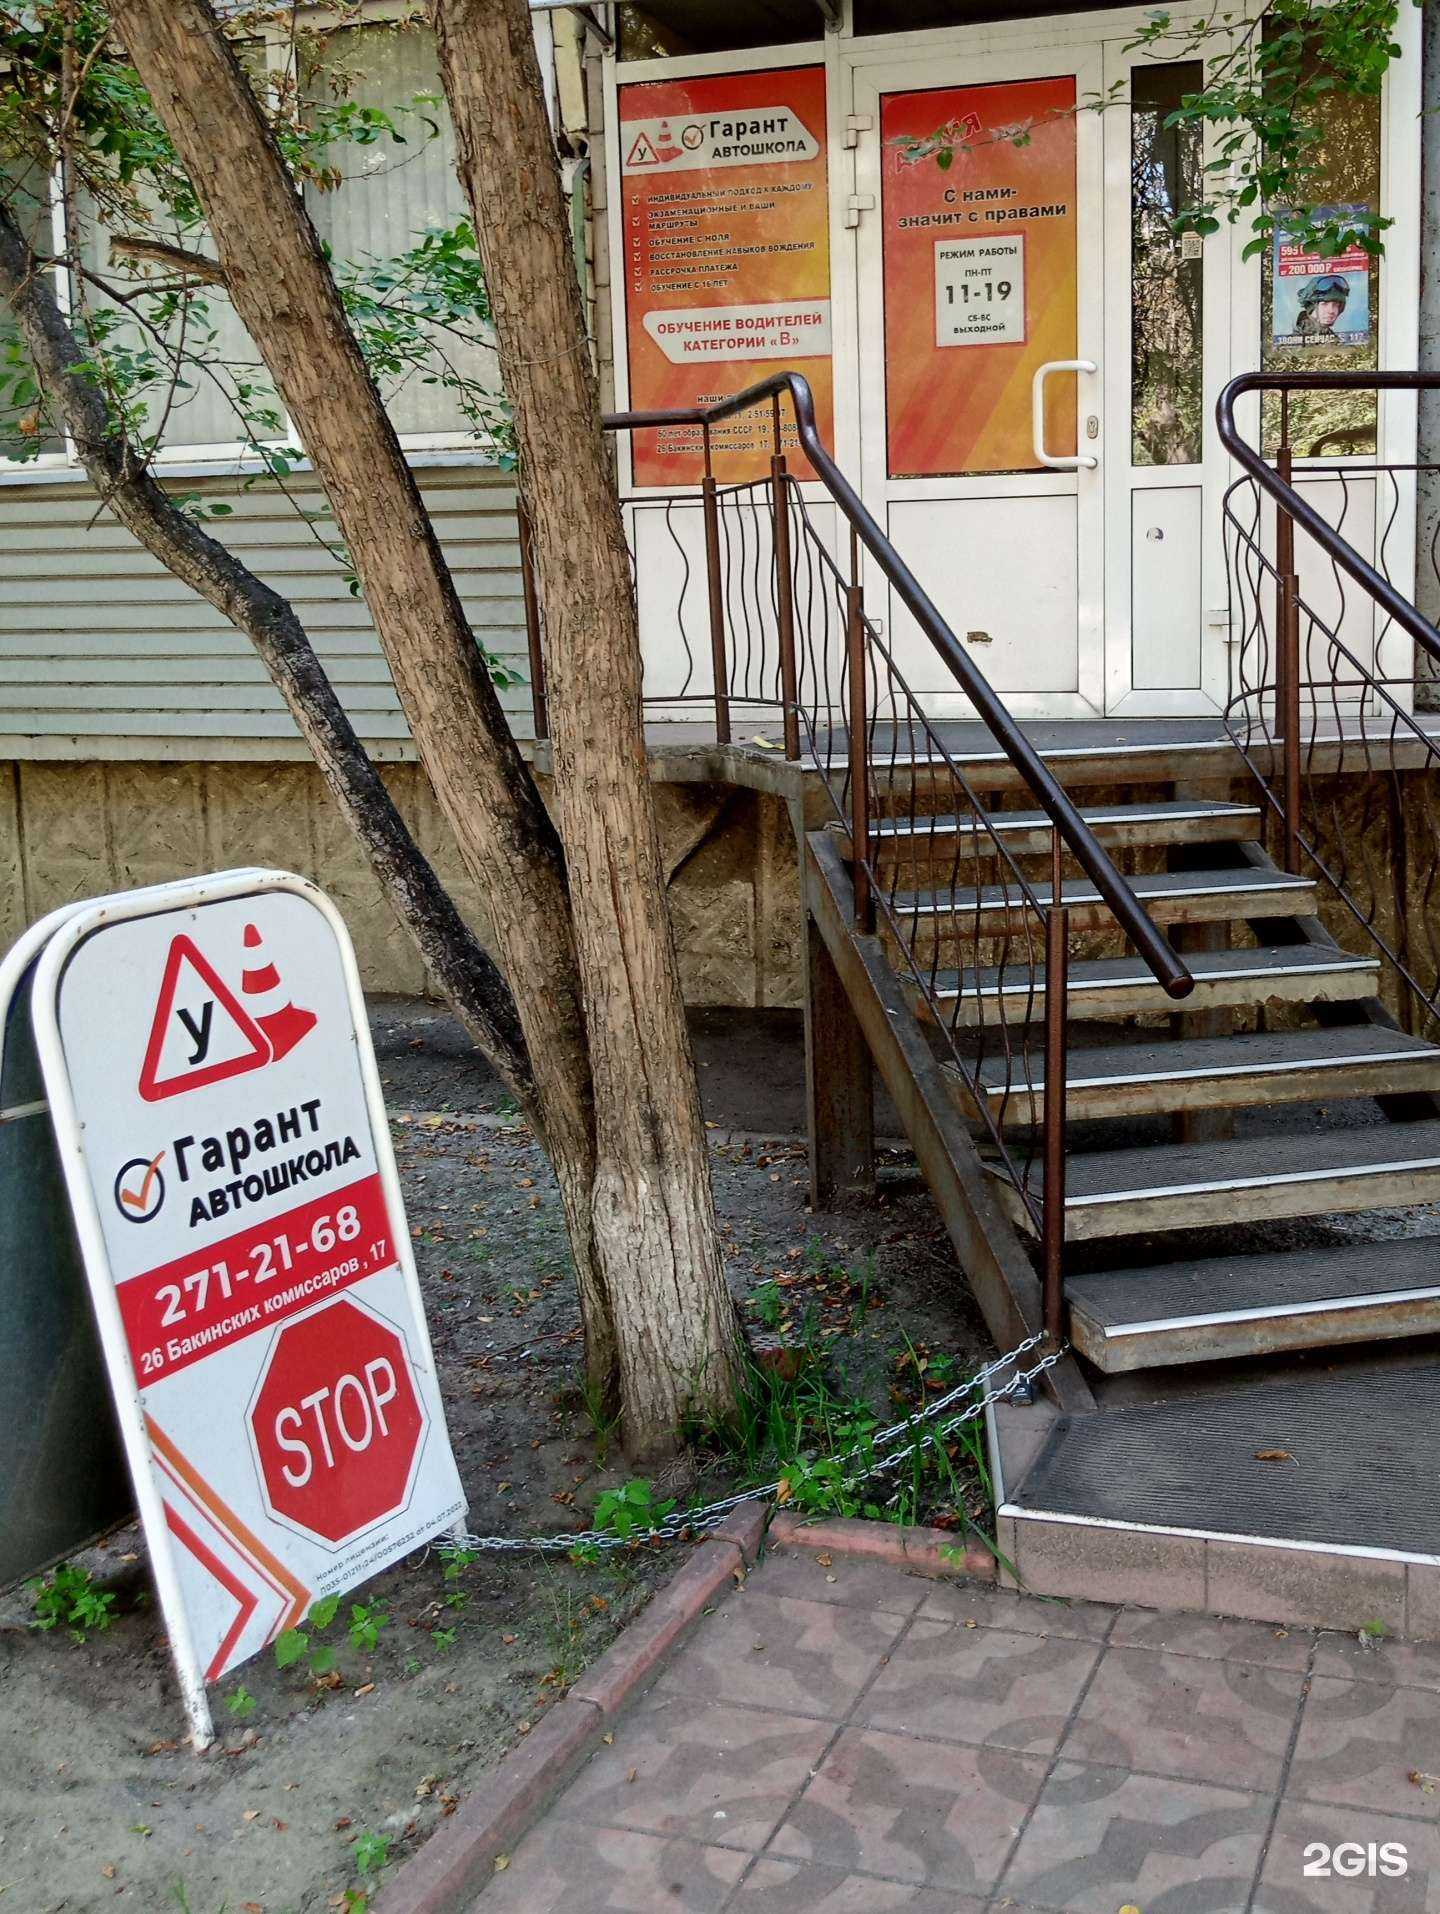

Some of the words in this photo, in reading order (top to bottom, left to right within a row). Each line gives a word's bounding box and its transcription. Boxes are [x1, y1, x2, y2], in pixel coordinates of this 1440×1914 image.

[710, 117, 788, 141] Гарант
[712, 140, 807, 159] АВТОШКОЛА
[963, 187, 1017, 202] нами-
[648, 220, 698, 230] МАРШРУТЫ
[898, 214, 962, 228] значит
[968, 213, 978, 222] с
[985, 204, 1067, 223] правами
[649, 236, 695, 247] ОБУЧЕНИЕ
[705, 233, 730, 242] НОЛЯ
[650, 248, 725, 260] ВОССТАНОВЛЕНИЕ
[727, 245, 766, 255] НАВЫКОВ
[768, 241, 815, 252] ВОЖДЕНИЯ
[940, 249, 975, 260] РЕЖИМ
[979, 246, 1018, 257] РАБОТЫ
[650, 266, 697, 276] РАССРОЧКА
[699, 263, 738, 273] ПЛАТЕЖА
[965, 268, 992, 278] ПН-ПТ
[1288, 265, 1305, 275] 200
[651, 282, 693, 291] ОБУЧЕНИЕ
[946, 281, 1012, 304] 11-19
[657, 319, 731, 335] ОБУЧЕНИЕ
[735, 312, 822, 331] ВОДИТЕЛЕЙ
[683, 336, 765, 352] КАТЕГОРИИ
[668, 443, 709, 452] Бакински
[173, 1099, 322, 1183] Гарант
[189, 1136, 361, 1228] АВТОШКОЛА
[155, 1205, 361, 1328] 271-21-68
[140, 1347, 164, 1375] 26
[166, 1306, 262, 1361] Бакинских
[369, 1240, 387, 1261] 17
[275, 1357, 398, 1488] STOP
[316, 1561, 344, 1581] Номер
